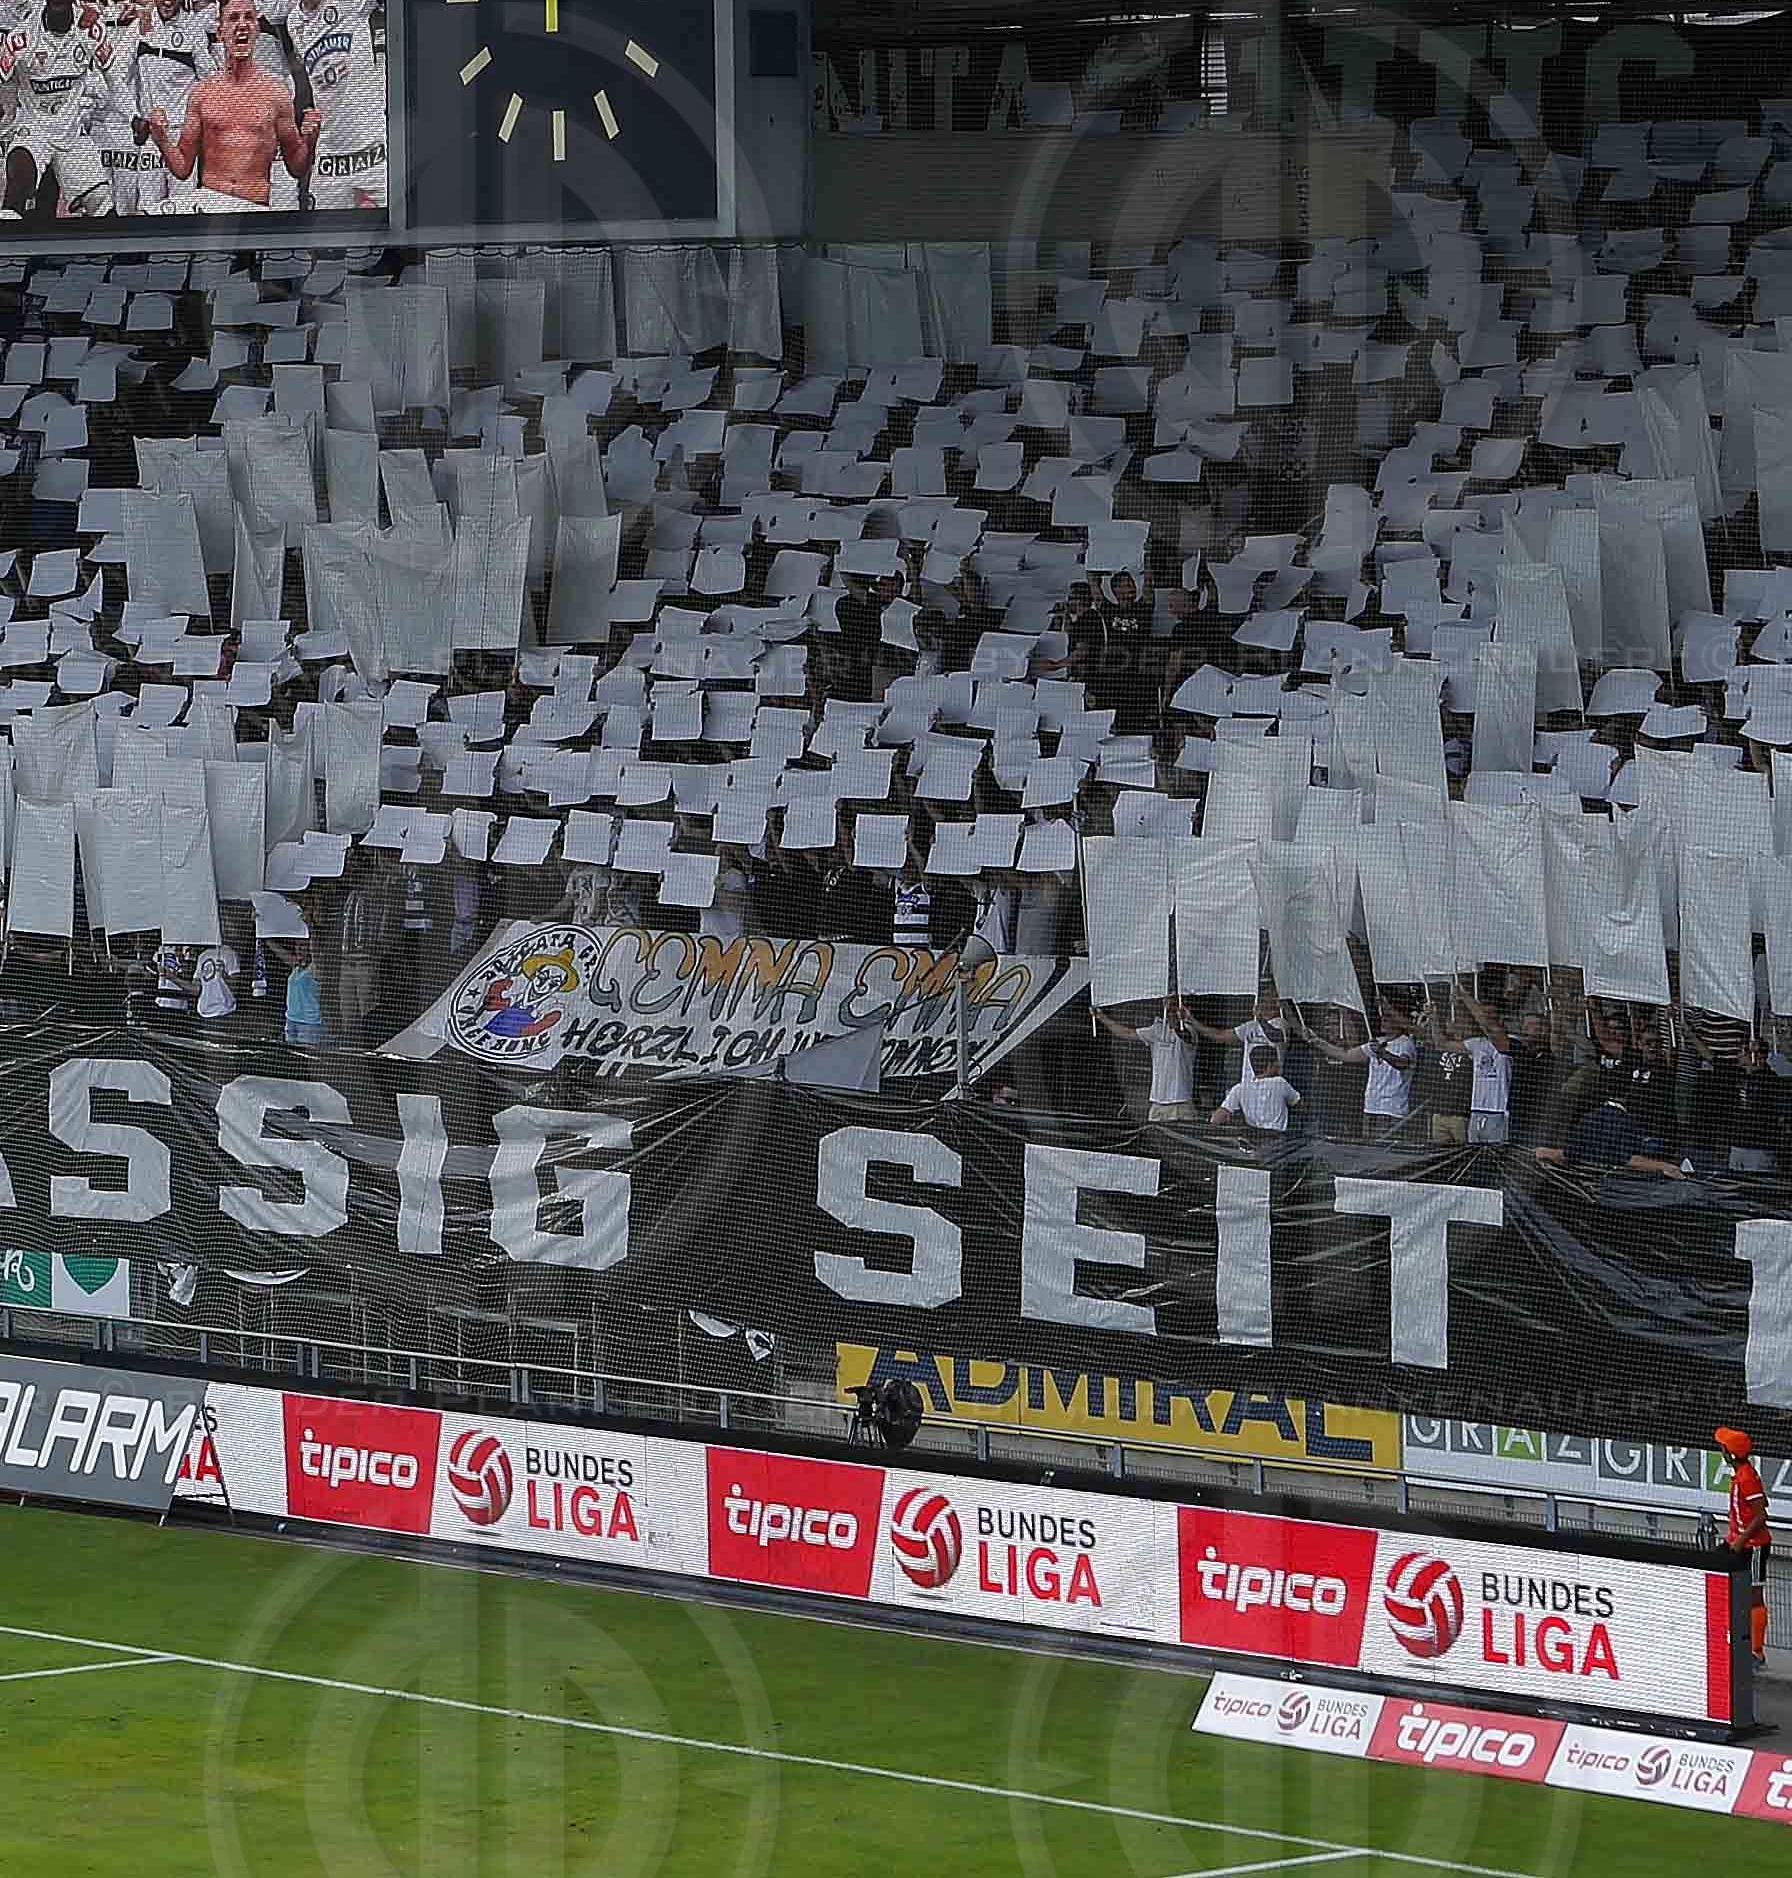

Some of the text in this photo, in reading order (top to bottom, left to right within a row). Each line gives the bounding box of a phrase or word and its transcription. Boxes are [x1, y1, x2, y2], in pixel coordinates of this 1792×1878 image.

[814, 1128, 1503, 1370] SEIT
[299, 1428, 419, 1489] tipico
[527, 1447, 634, 1487] BUNDES
[527, 1480, 640, 1542] LIGA
[724, 1483, 858, 1550] tipico
[978, 1507, 1096, 1549] BUNDES
[979, 1541, 1103, 1607] LIGA
[1197, 1546, 1347, 1615] tipico
[1482, 1572, 1615, 1618] BUNDES
[1482, 1609, 1621, 1680] LIGA
[1213, 1695, 1271, 1720] tipico
[1309, 1715, 1363, 1741] LIGA
[1317, 1698, 1369, 1720] BUNDES
[1395, 1701, 1537, 1768] tipico
[1567, 1747, 1629, 1773] tipico
[1679, 1752, 1735, 1774] BUNDES
[1670, 1769, 1729, 1798] LIGA
